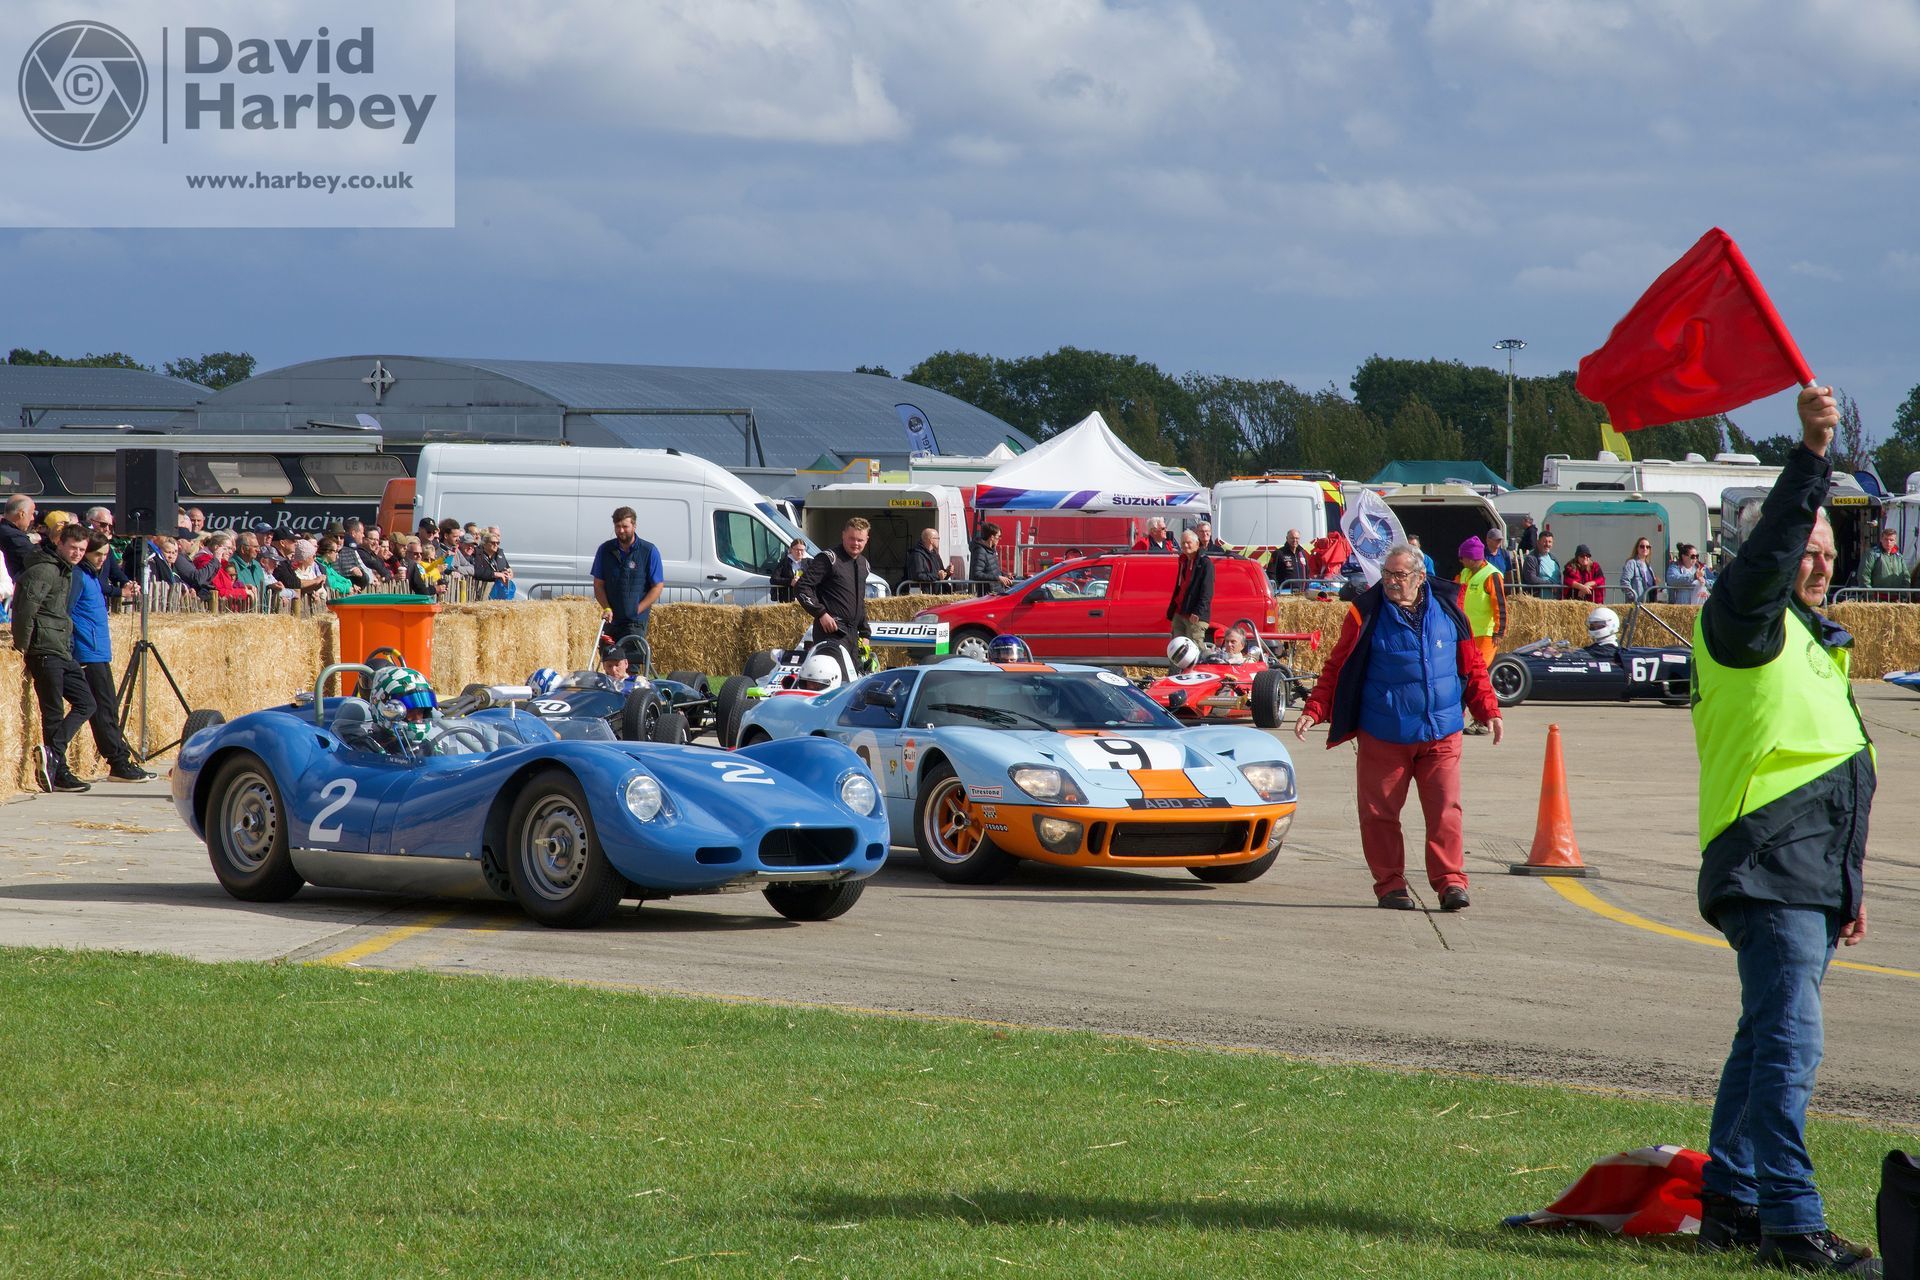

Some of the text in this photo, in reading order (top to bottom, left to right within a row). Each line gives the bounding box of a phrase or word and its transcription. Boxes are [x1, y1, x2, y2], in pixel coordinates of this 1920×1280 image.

[345, 461, 358, 471] LE
[365, 461, 398, 471] MANS
[1112, 496, 1165, 506] SUZUKI
[206, 510, 360, 530] toric Racin
[875, 624, 937, 636] saudia
[1632, 657, 1660, 682] 67
[903, 749, 916, 760] Gulf
[1093, 738, 1152, 770] 9
[711, 761, 775, 784] 2
[308, 778, 357, 842] 2
[1145, 798, 1214, 809] ABD 3F
